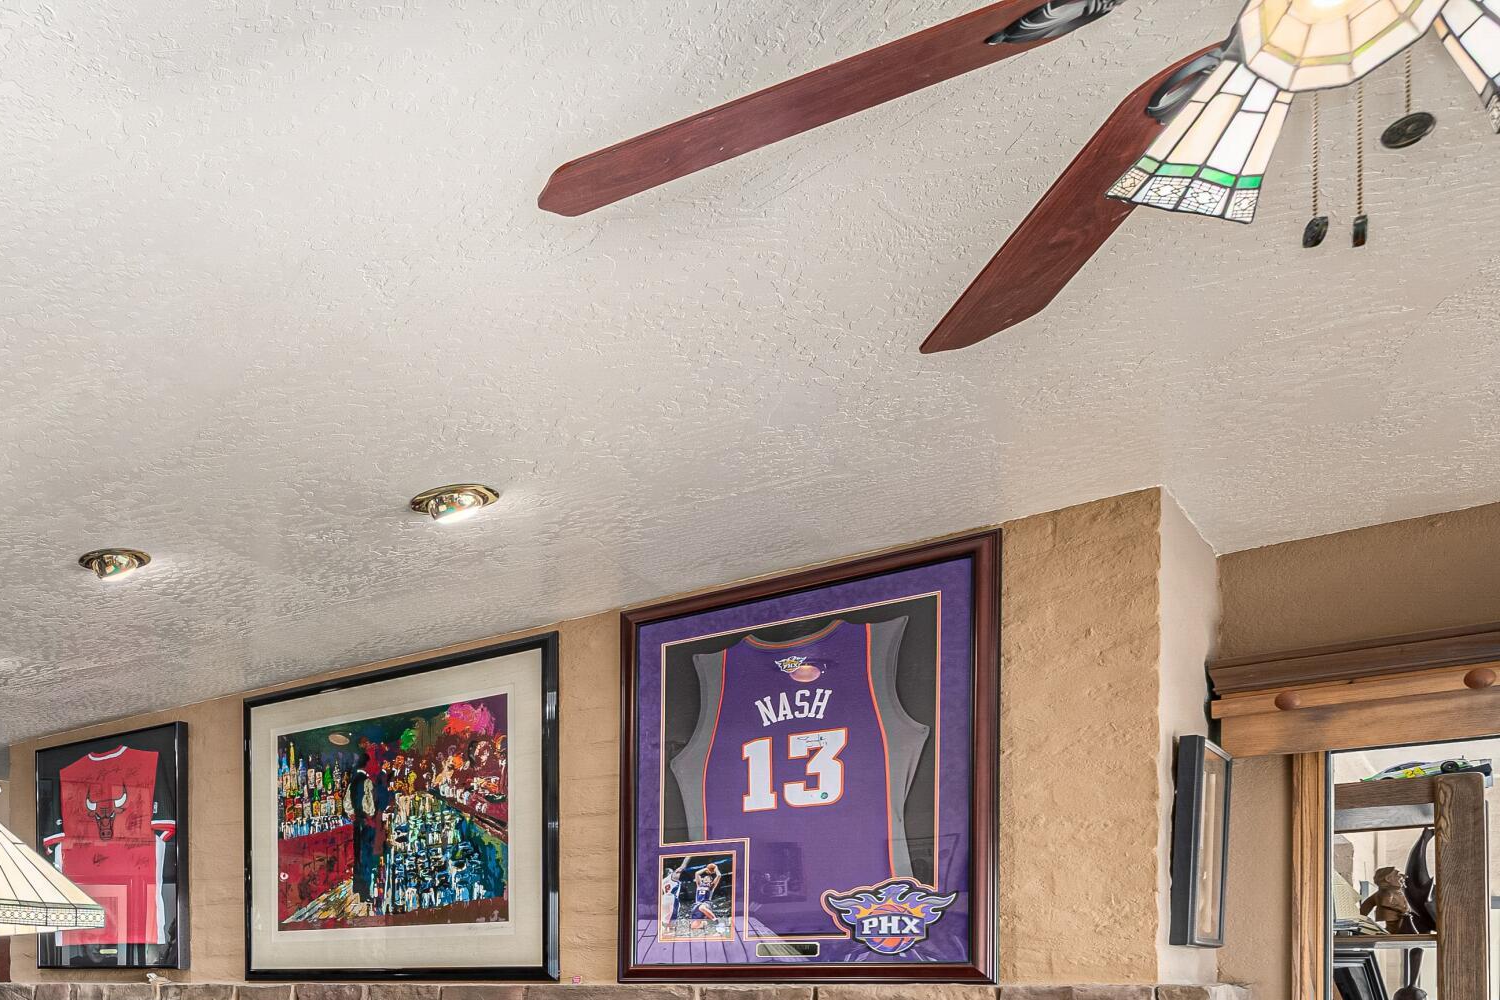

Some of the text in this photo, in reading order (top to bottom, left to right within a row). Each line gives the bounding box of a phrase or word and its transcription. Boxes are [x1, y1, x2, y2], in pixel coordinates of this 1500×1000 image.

[755, 688, 832, 727] NASH
[742, 727, 848, 812] 13
[861, 915, 920, 935] PHX
